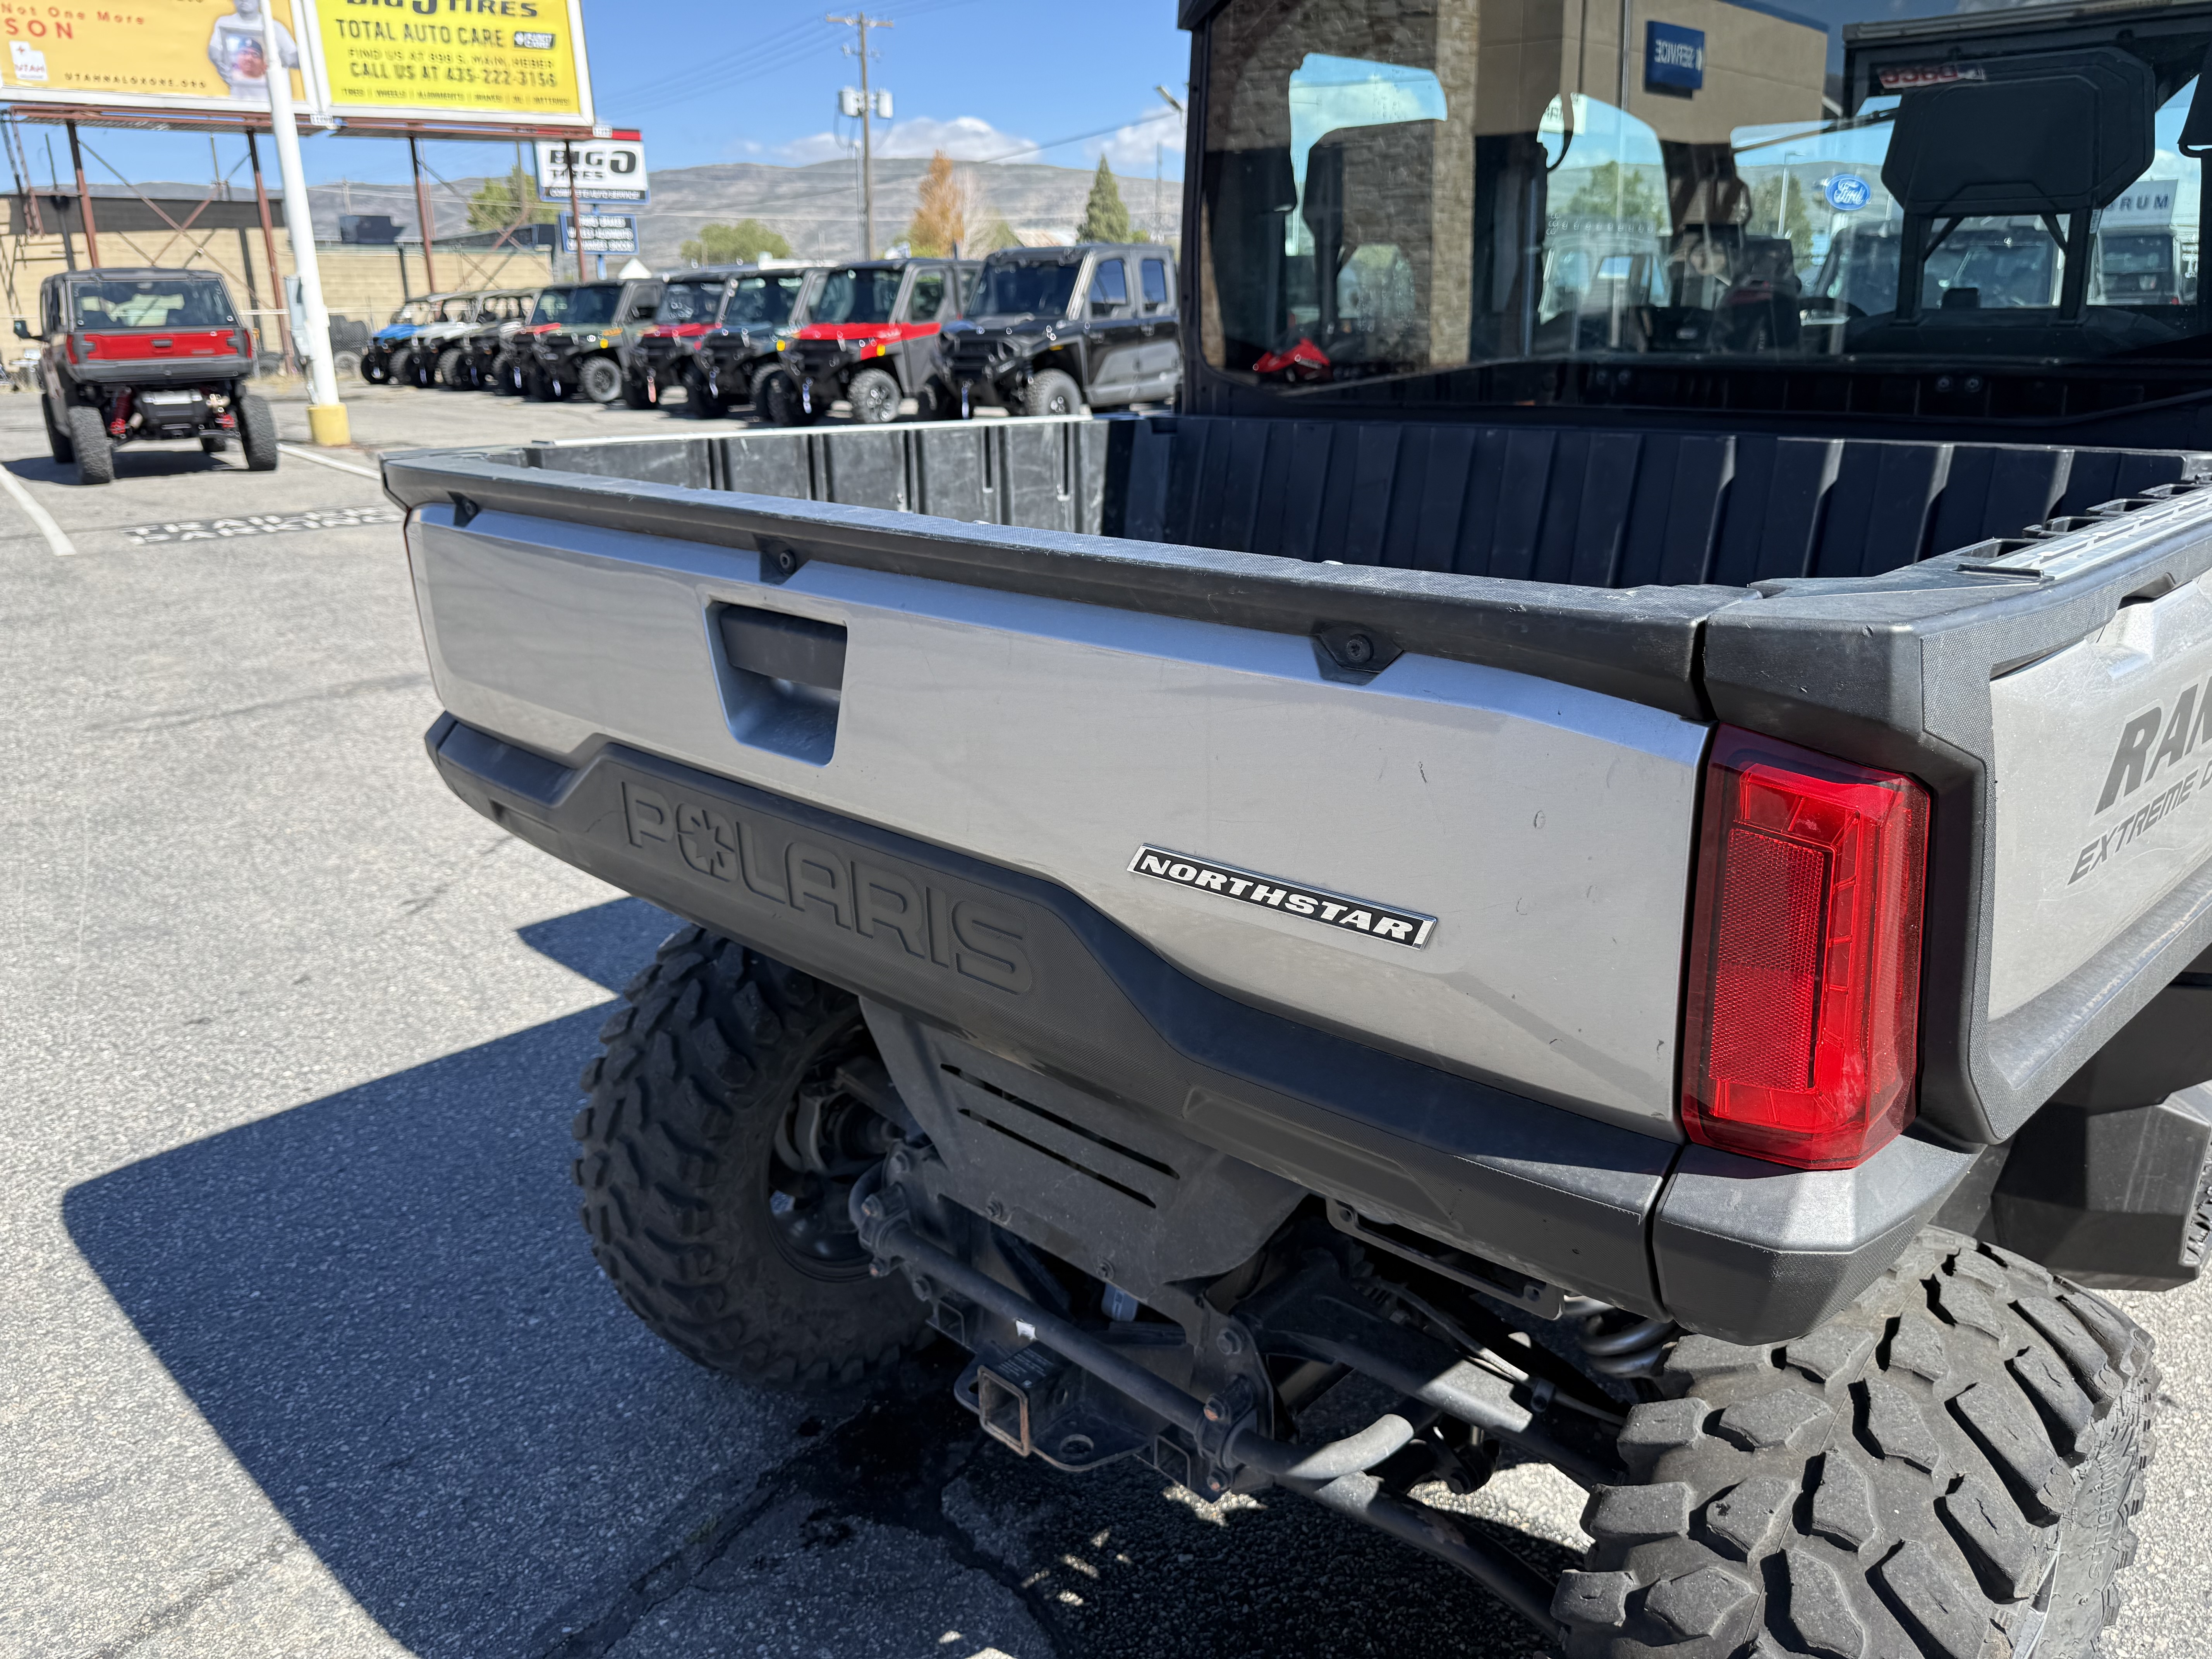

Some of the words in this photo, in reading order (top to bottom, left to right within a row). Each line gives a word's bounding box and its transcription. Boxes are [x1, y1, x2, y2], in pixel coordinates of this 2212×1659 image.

[0, 3, 38, 16] Not
[47, 6, 86, 20] One
[97, 11, 144, 25] More
[4, 18, 74, 40] SON
[336, 18, 396, 40] TOTAL
[404, 22, 452, 44] AUTO
[457, 26, 505, 47] CARE
[349, 62, 389, 79] CALL
[392, 64, 416, 80] US
[421, 65, 439, 81] AT
[1834, 180, 1866, 205] Ford
[2067, 769, 2199, 886] EXTREME
[621, 781, 1032, 995] POLARIS
[1140, 854, 1413, 940] NORTHSTAR
